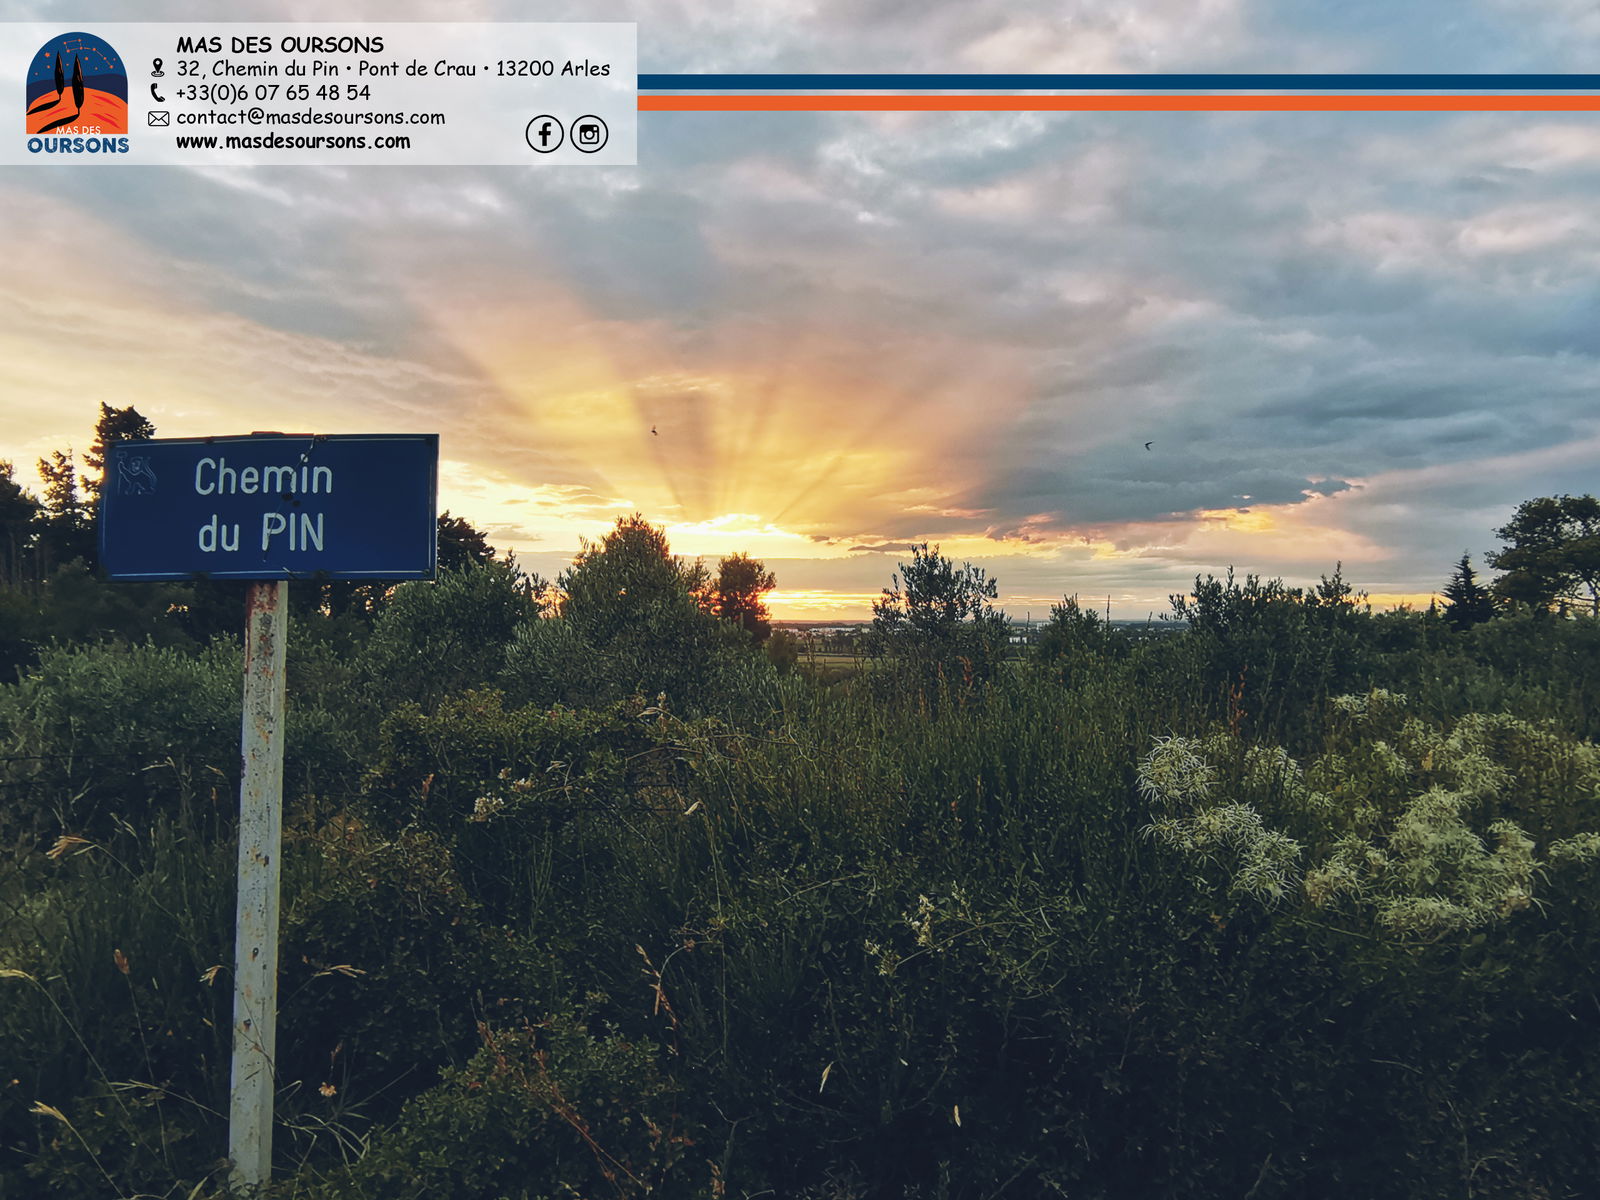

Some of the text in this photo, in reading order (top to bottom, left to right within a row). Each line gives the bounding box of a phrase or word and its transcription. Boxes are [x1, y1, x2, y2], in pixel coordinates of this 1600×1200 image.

[194, 453, 333, 496] Chemin
[198, 512, 325, 552] du PIN
